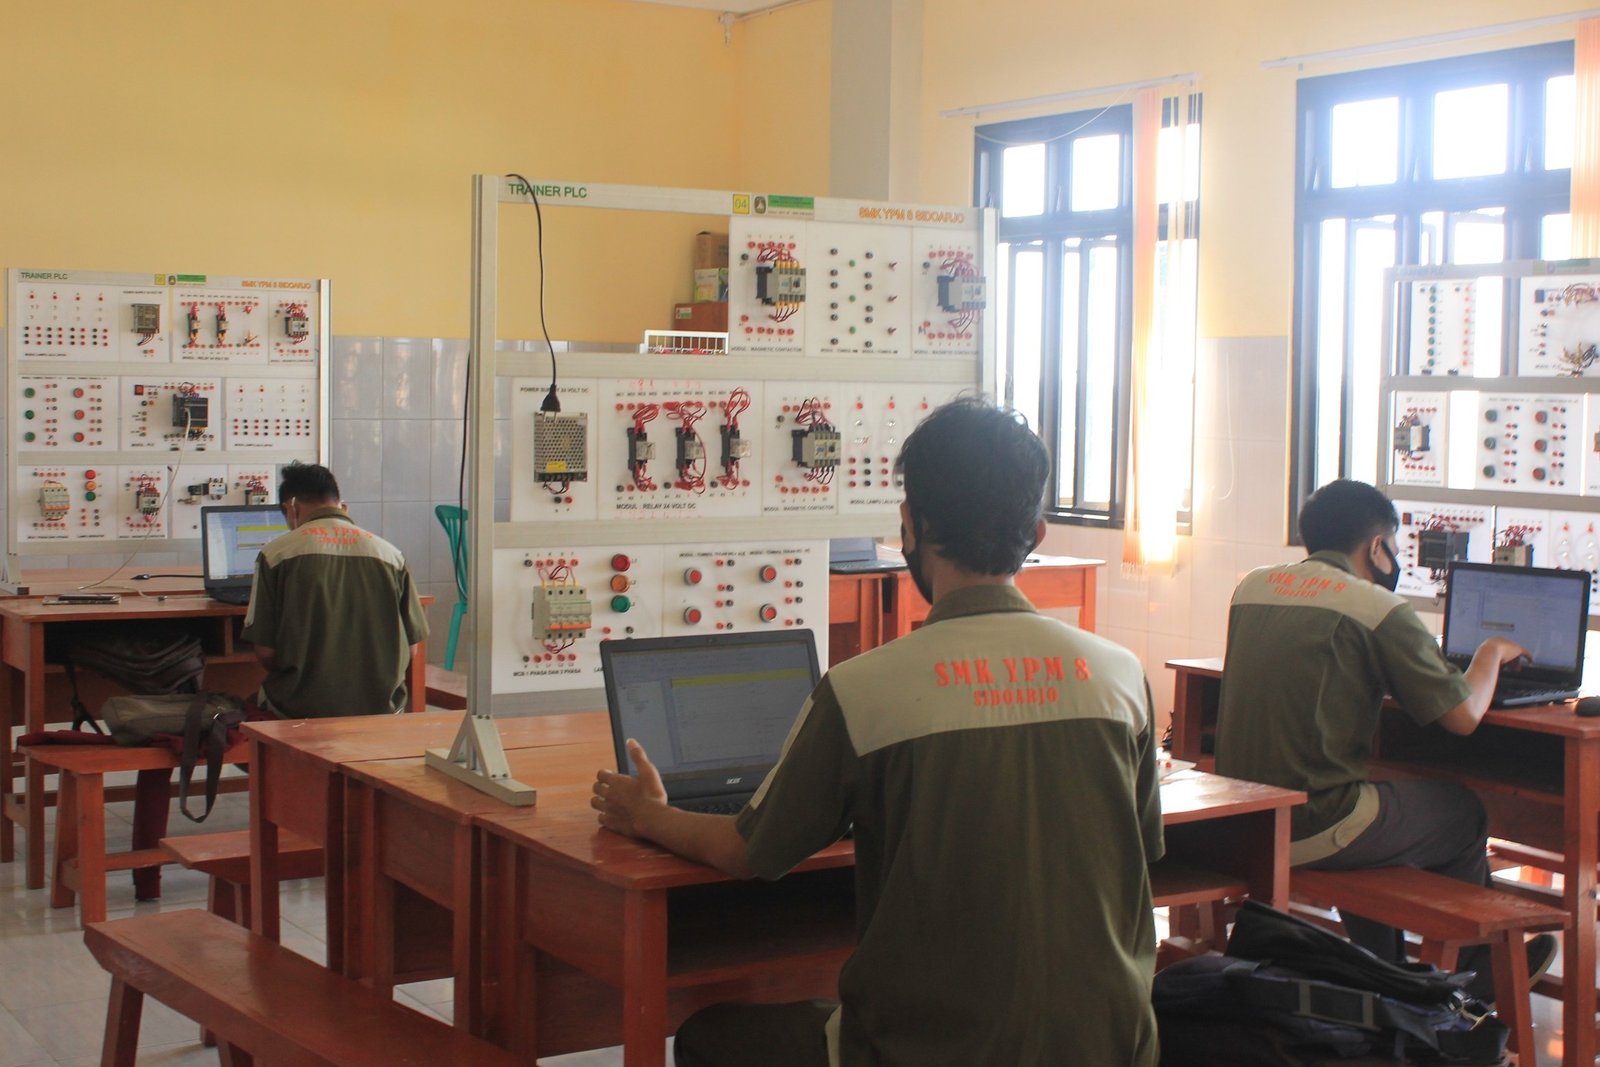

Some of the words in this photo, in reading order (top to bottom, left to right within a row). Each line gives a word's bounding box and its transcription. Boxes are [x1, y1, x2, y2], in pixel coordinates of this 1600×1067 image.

[508, 183, 561, 197] TRAINER
[564, 186, 588, 199] PLC
[735, 199, 747, 210] 04
[21, 272, 52, 280] TRAINER
[54, 273, 68, 281] PLC
[934, 659, 993, 687] SMK
[1003, 656, 1065, 682] YPM
[1075, 656, 1090, 681] 8
[974, 687, 1058, 706] SIDOARJO
[726, 777, 742, 785] acer
